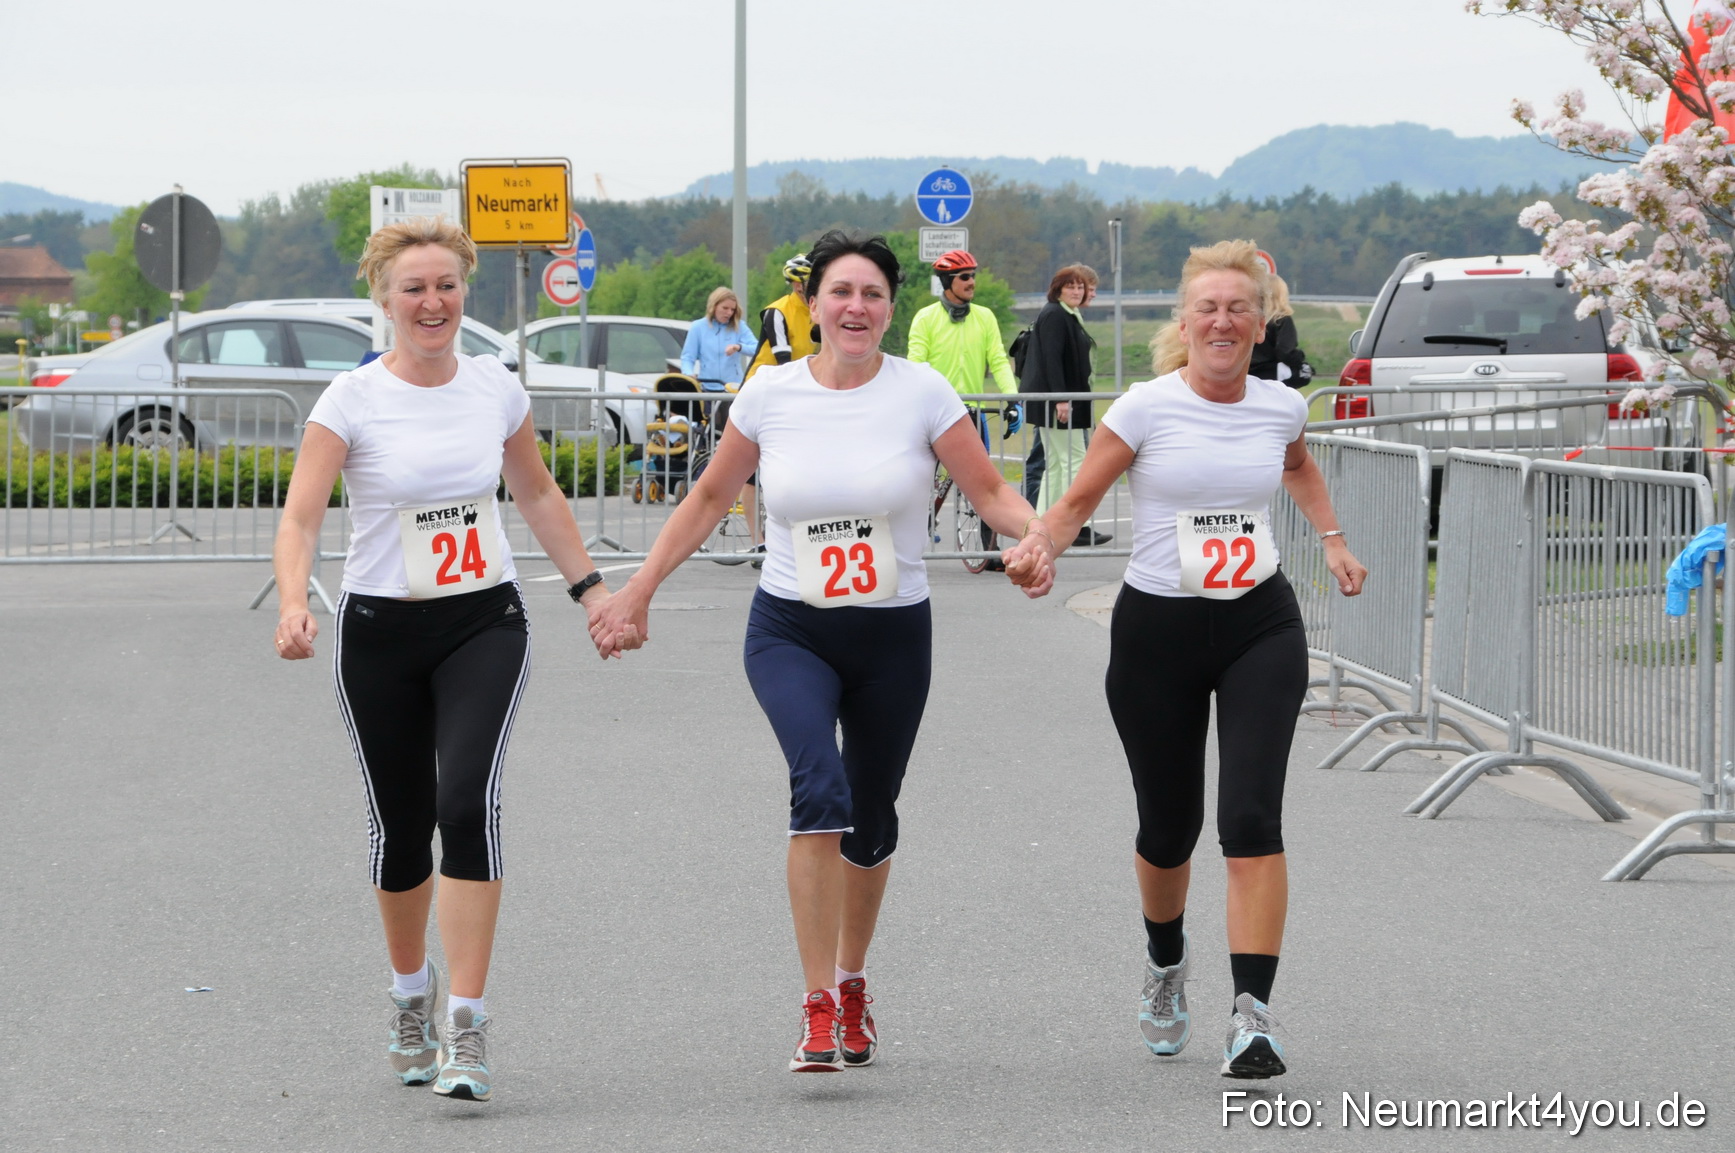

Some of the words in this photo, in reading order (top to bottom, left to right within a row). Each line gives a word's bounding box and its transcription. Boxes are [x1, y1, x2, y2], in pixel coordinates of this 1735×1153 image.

[503, 178, 531, 188] Nach
[476, 193, 559, 212] Neumarkt
[505, 220, 511, 230] 5
[519, 221, 534, 230] km
[928, 232, 961, 240] Landwirt-
[925, 241, 962, 249] schaftlicher
[1479, 366, 1497, 375] KIA
[416, 507, 459, 524] MEYER
[1193, 514, 1238, 526] MEYER
[416, 518, 462, 531] WERBUNG
[807, 520, 852, 535] MEYER
[1194, 525, 1239, 534] WERBUNG
[808, 531, 854, 543] WERBUNG
[431, 527, 487, 586] 24
[1202, 536, 1256, 589] 22
[821, 542, 877, 598] 23
